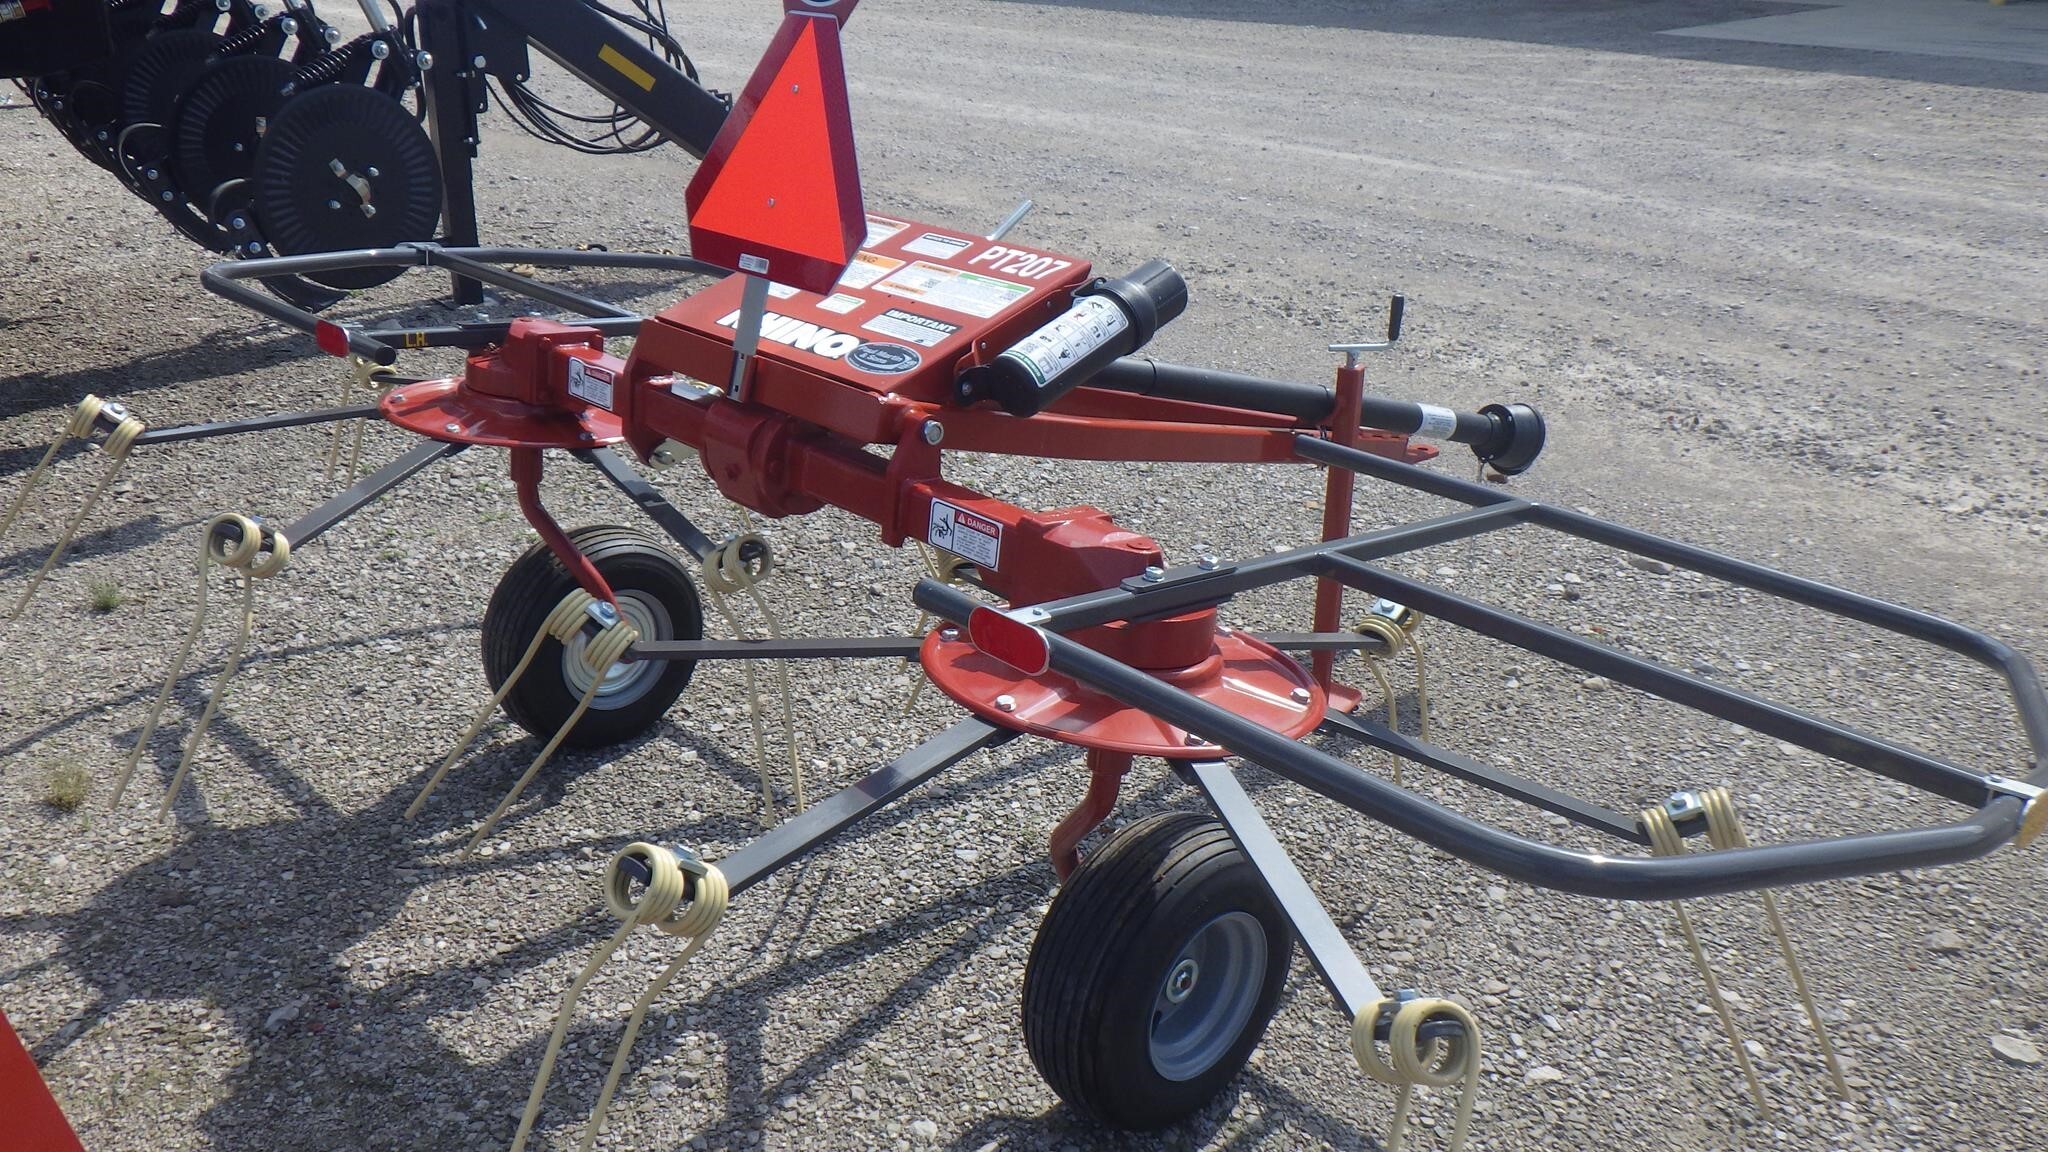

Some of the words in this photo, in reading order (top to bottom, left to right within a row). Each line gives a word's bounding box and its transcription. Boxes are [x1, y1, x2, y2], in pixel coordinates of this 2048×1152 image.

[967, 245, 1072, 280] PT207
[885, 309, 957, 332] IMPORTANT
[966, 518, 996, 536] DANGER
